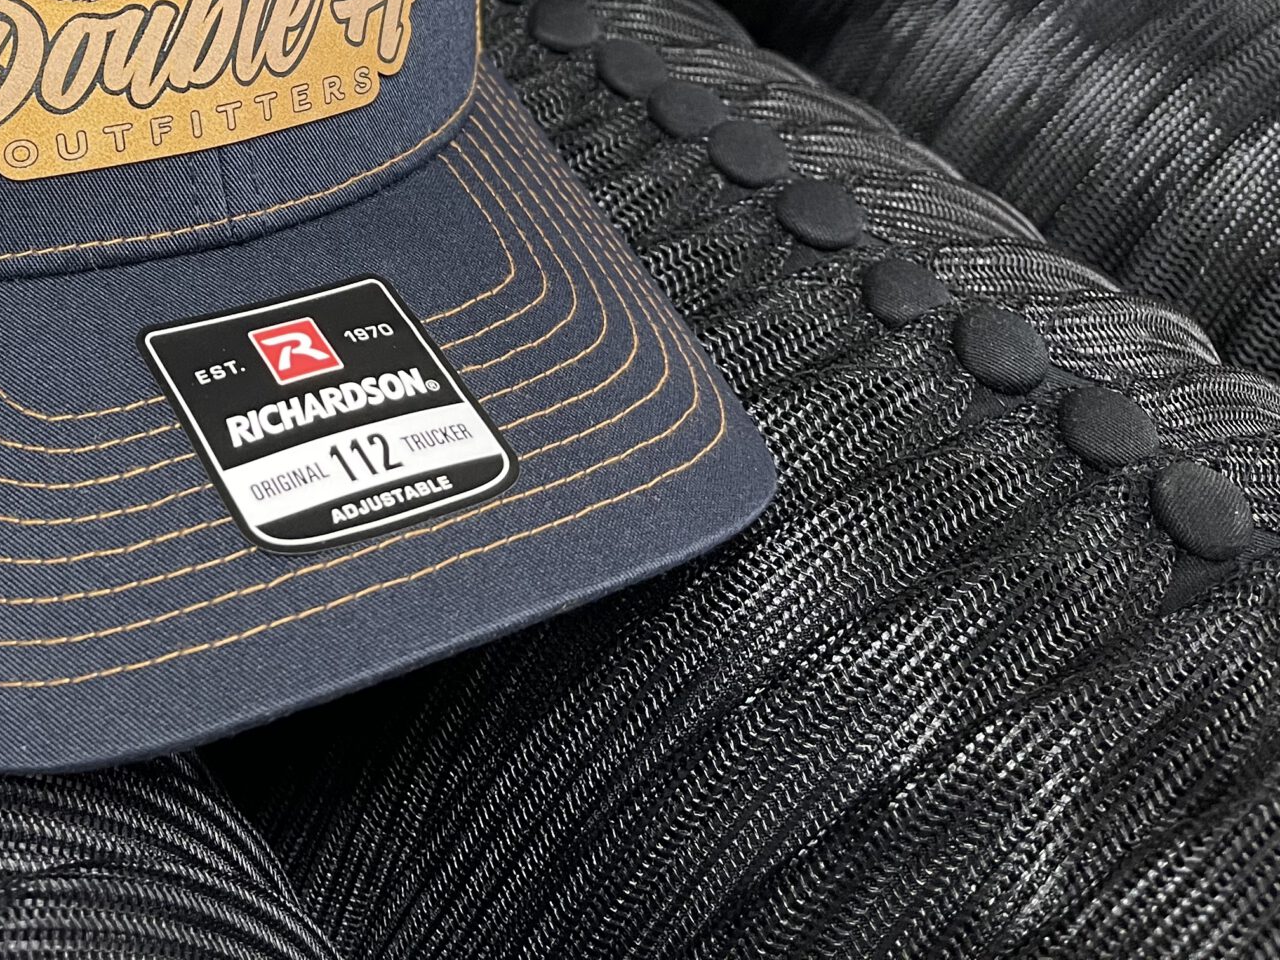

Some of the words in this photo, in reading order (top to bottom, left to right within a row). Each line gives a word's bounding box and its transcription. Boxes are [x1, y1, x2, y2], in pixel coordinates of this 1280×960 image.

[3, 64, 375, 169] OUTFITTERS
[194, 360, 246, 386] EST.
[343, 322, 395, 344] 1970
[250, 461, 330, 502] ORIGINAL
[328, 432, 403, 483] 112
[400, 422, 474, 456] TRUCKER
[330, 474, 454, 525] ADJUSTABLE
